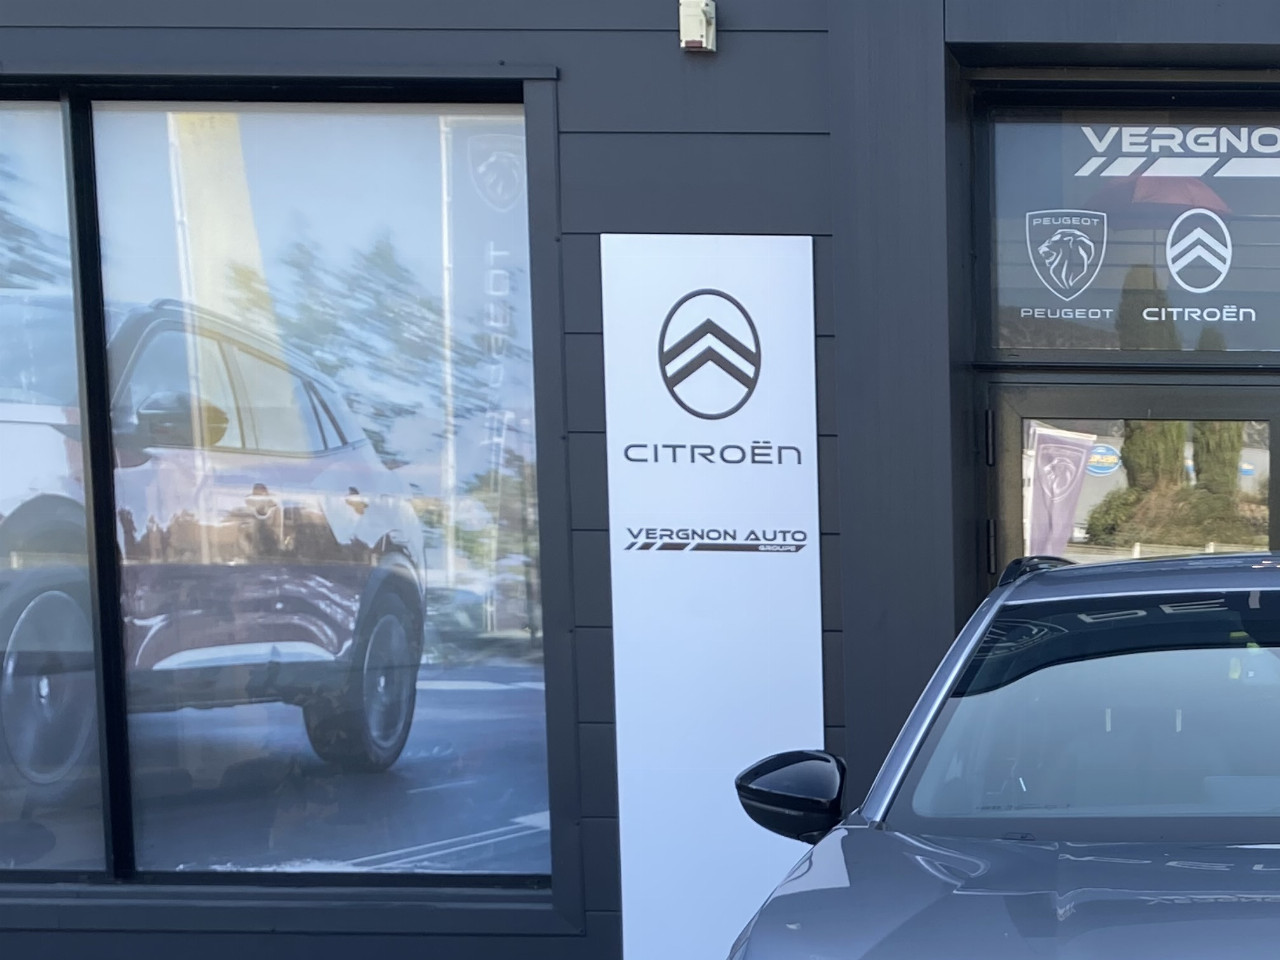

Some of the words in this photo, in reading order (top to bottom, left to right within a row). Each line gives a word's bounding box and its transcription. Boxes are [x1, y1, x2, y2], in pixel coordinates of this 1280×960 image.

[1033, 217, 1099, 226] PEUGEOT
[1020, 308, 1113, 319] PEUGEOT
[627, 528, 737, 541] VERGNON
[744, 529, 807, 542] AUTO
